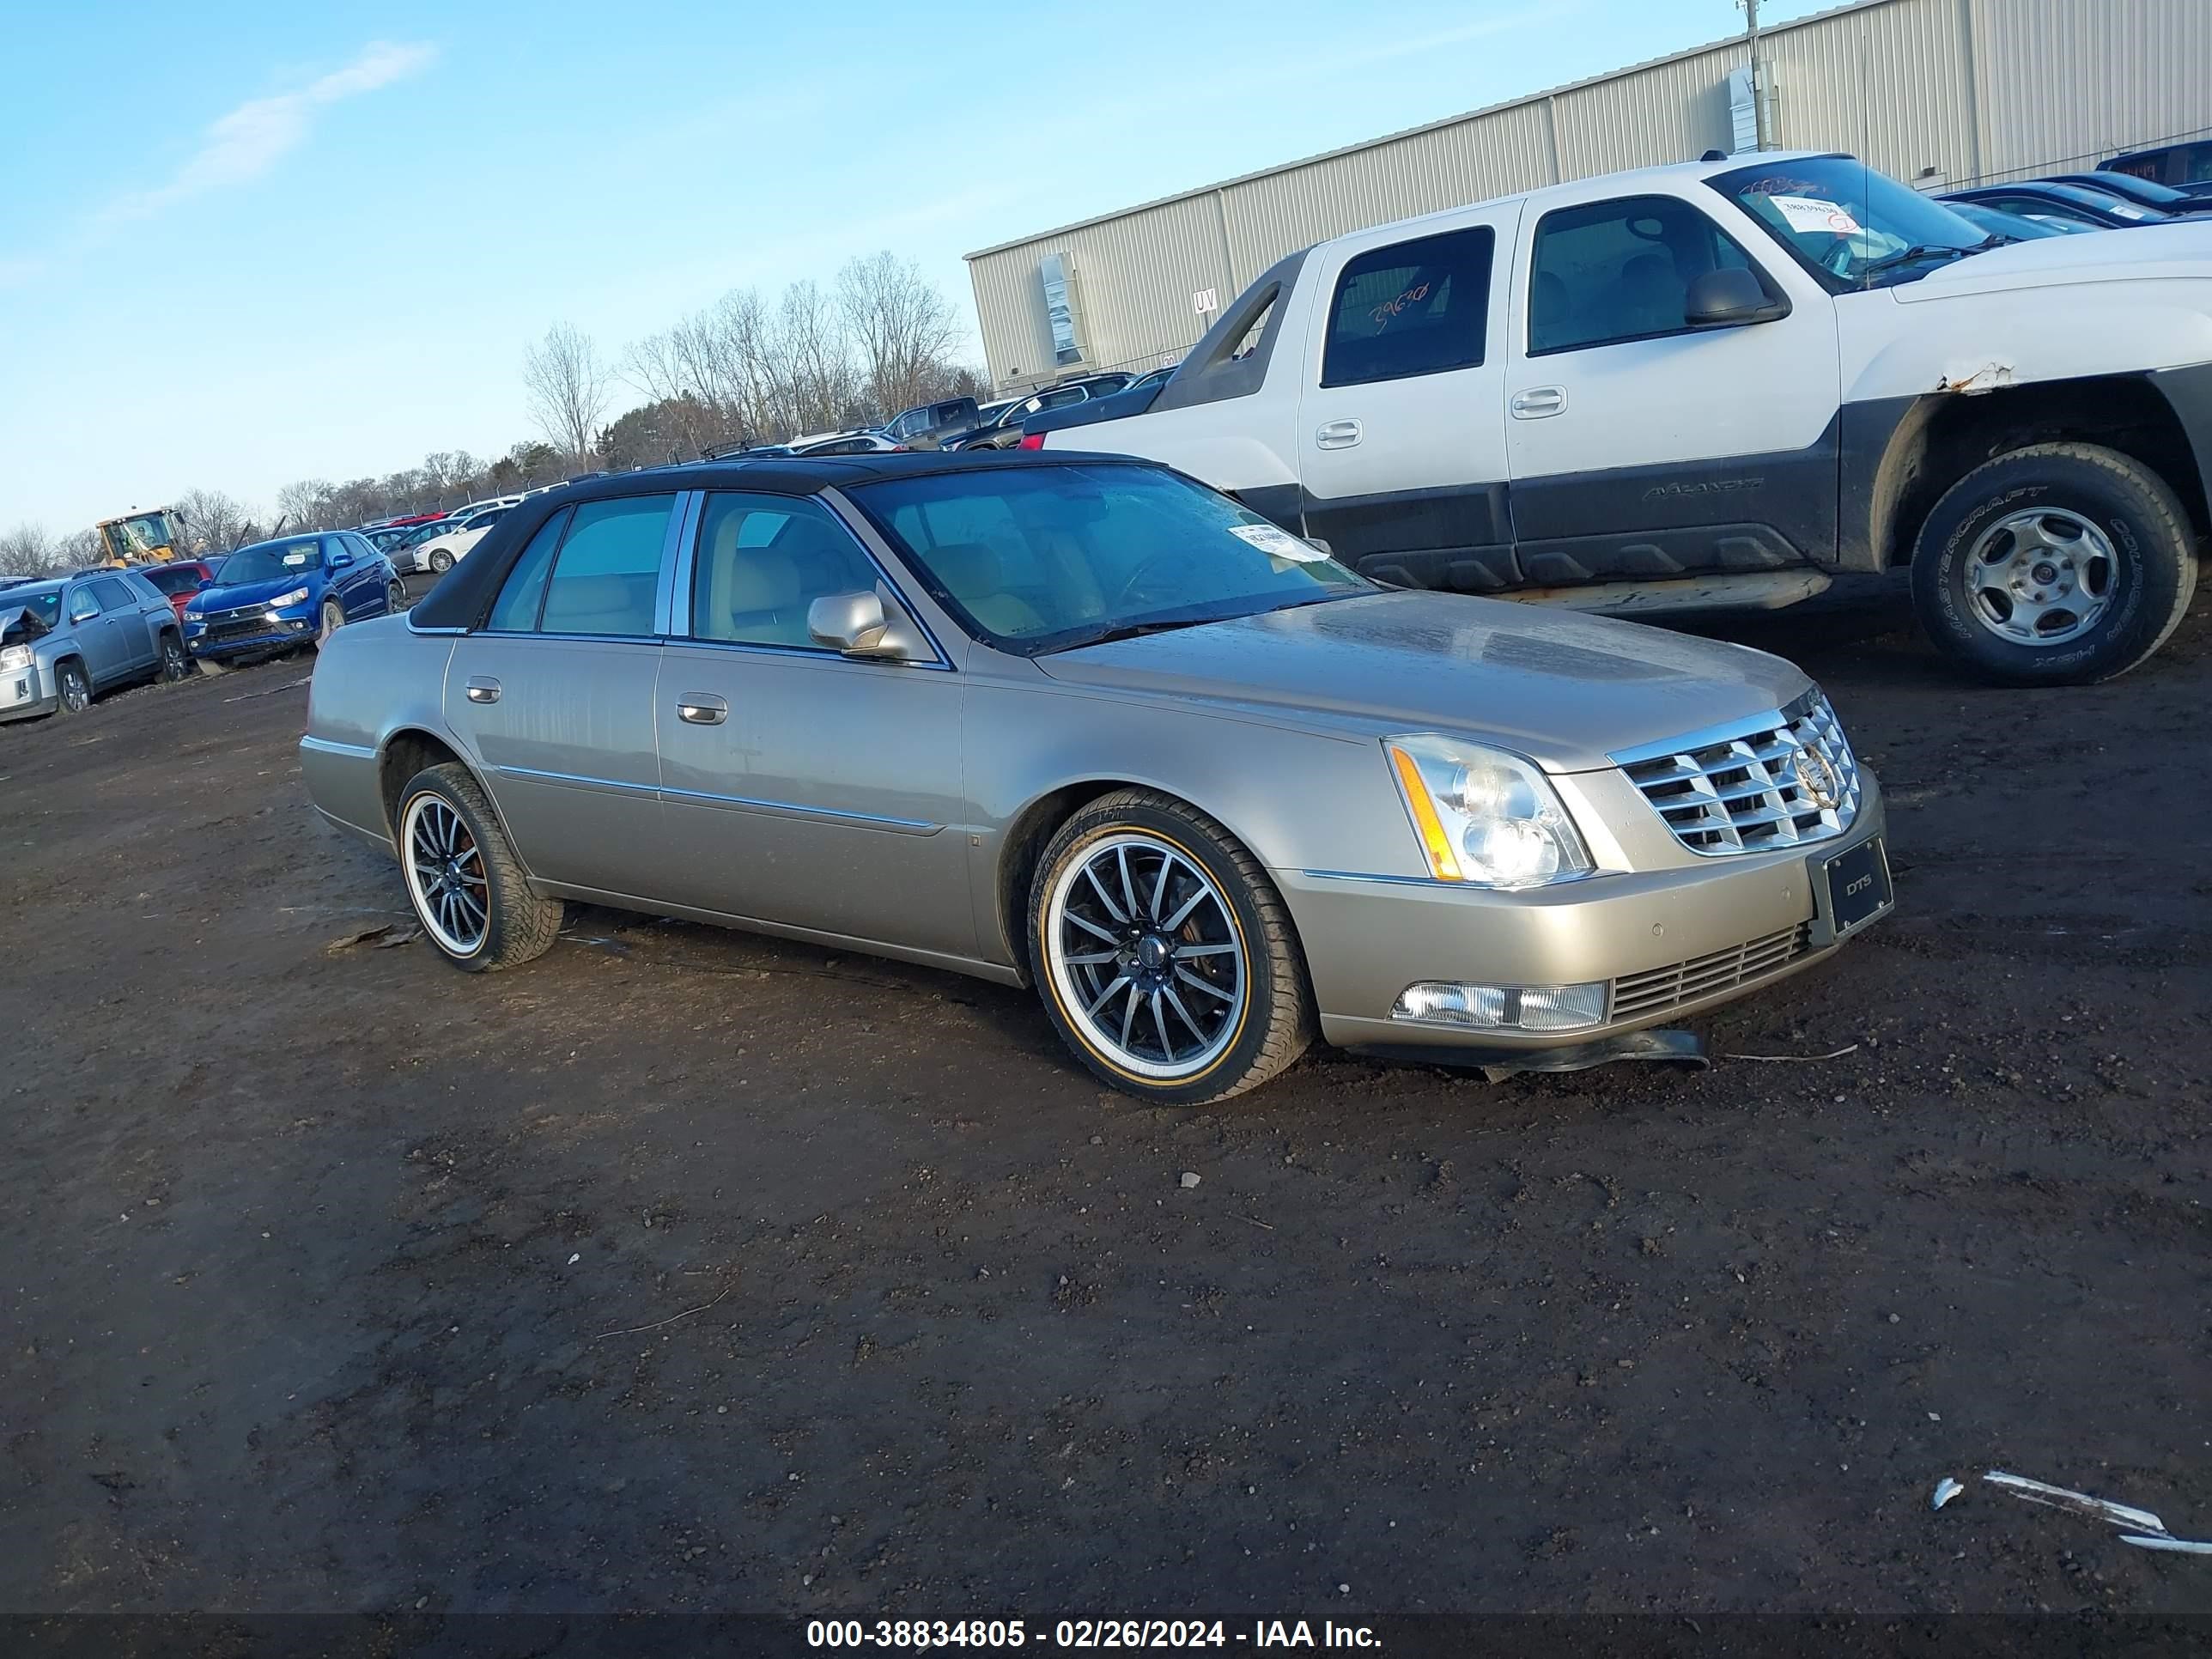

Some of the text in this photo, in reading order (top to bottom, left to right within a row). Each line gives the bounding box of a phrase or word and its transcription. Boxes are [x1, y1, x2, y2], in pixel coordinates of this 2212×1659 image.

[1195, 290, 1214, 311] UV
[1937, 485, 2048, 640] MASTERCRAFT
[2107, 518, 2143, 640] COURSER
[1846, 873, 1872, 896] DTS
